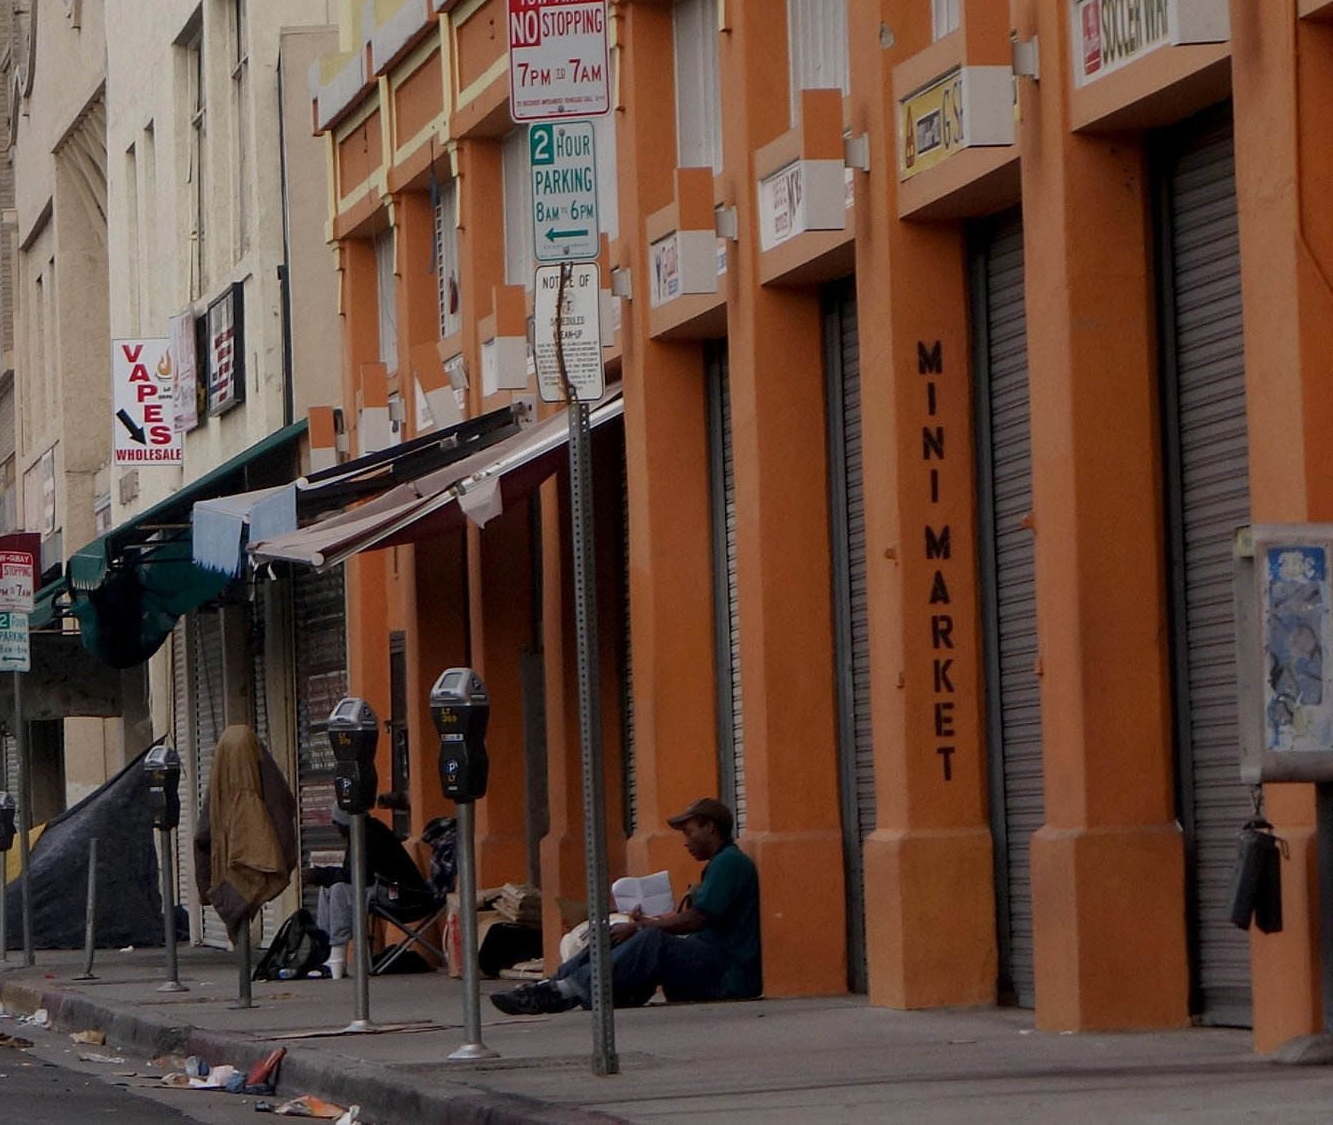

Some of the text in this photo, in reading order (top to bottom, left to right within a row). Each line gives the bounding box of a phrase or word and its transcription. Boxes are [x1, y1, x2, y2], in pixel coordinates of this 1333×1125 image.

[512, 9, 602, 45] NO STOPPING
[517, 62, 551, 87] 7PM
[569, 58, 601, 83] 7AM
[534, 129, 590, 160] 2 HOUR
[536, 167, 593, 195] PARKING
[536, 202, 559, 222] 8AM
[570, 200, 593, 220] 6PM
[579, 274, 590, 288] OF
[121, 344, 172, 445] VAPES
[918, 339, 944, 504] MINI
[116, 449, 181, 461] WHOLESALE
[4, 565, 31, 577] STOPPING
[16, 584, 31, 596] 7AM
[0, 631, 27, 643] PARKING
[925, 524, 955, 782] MARKET
